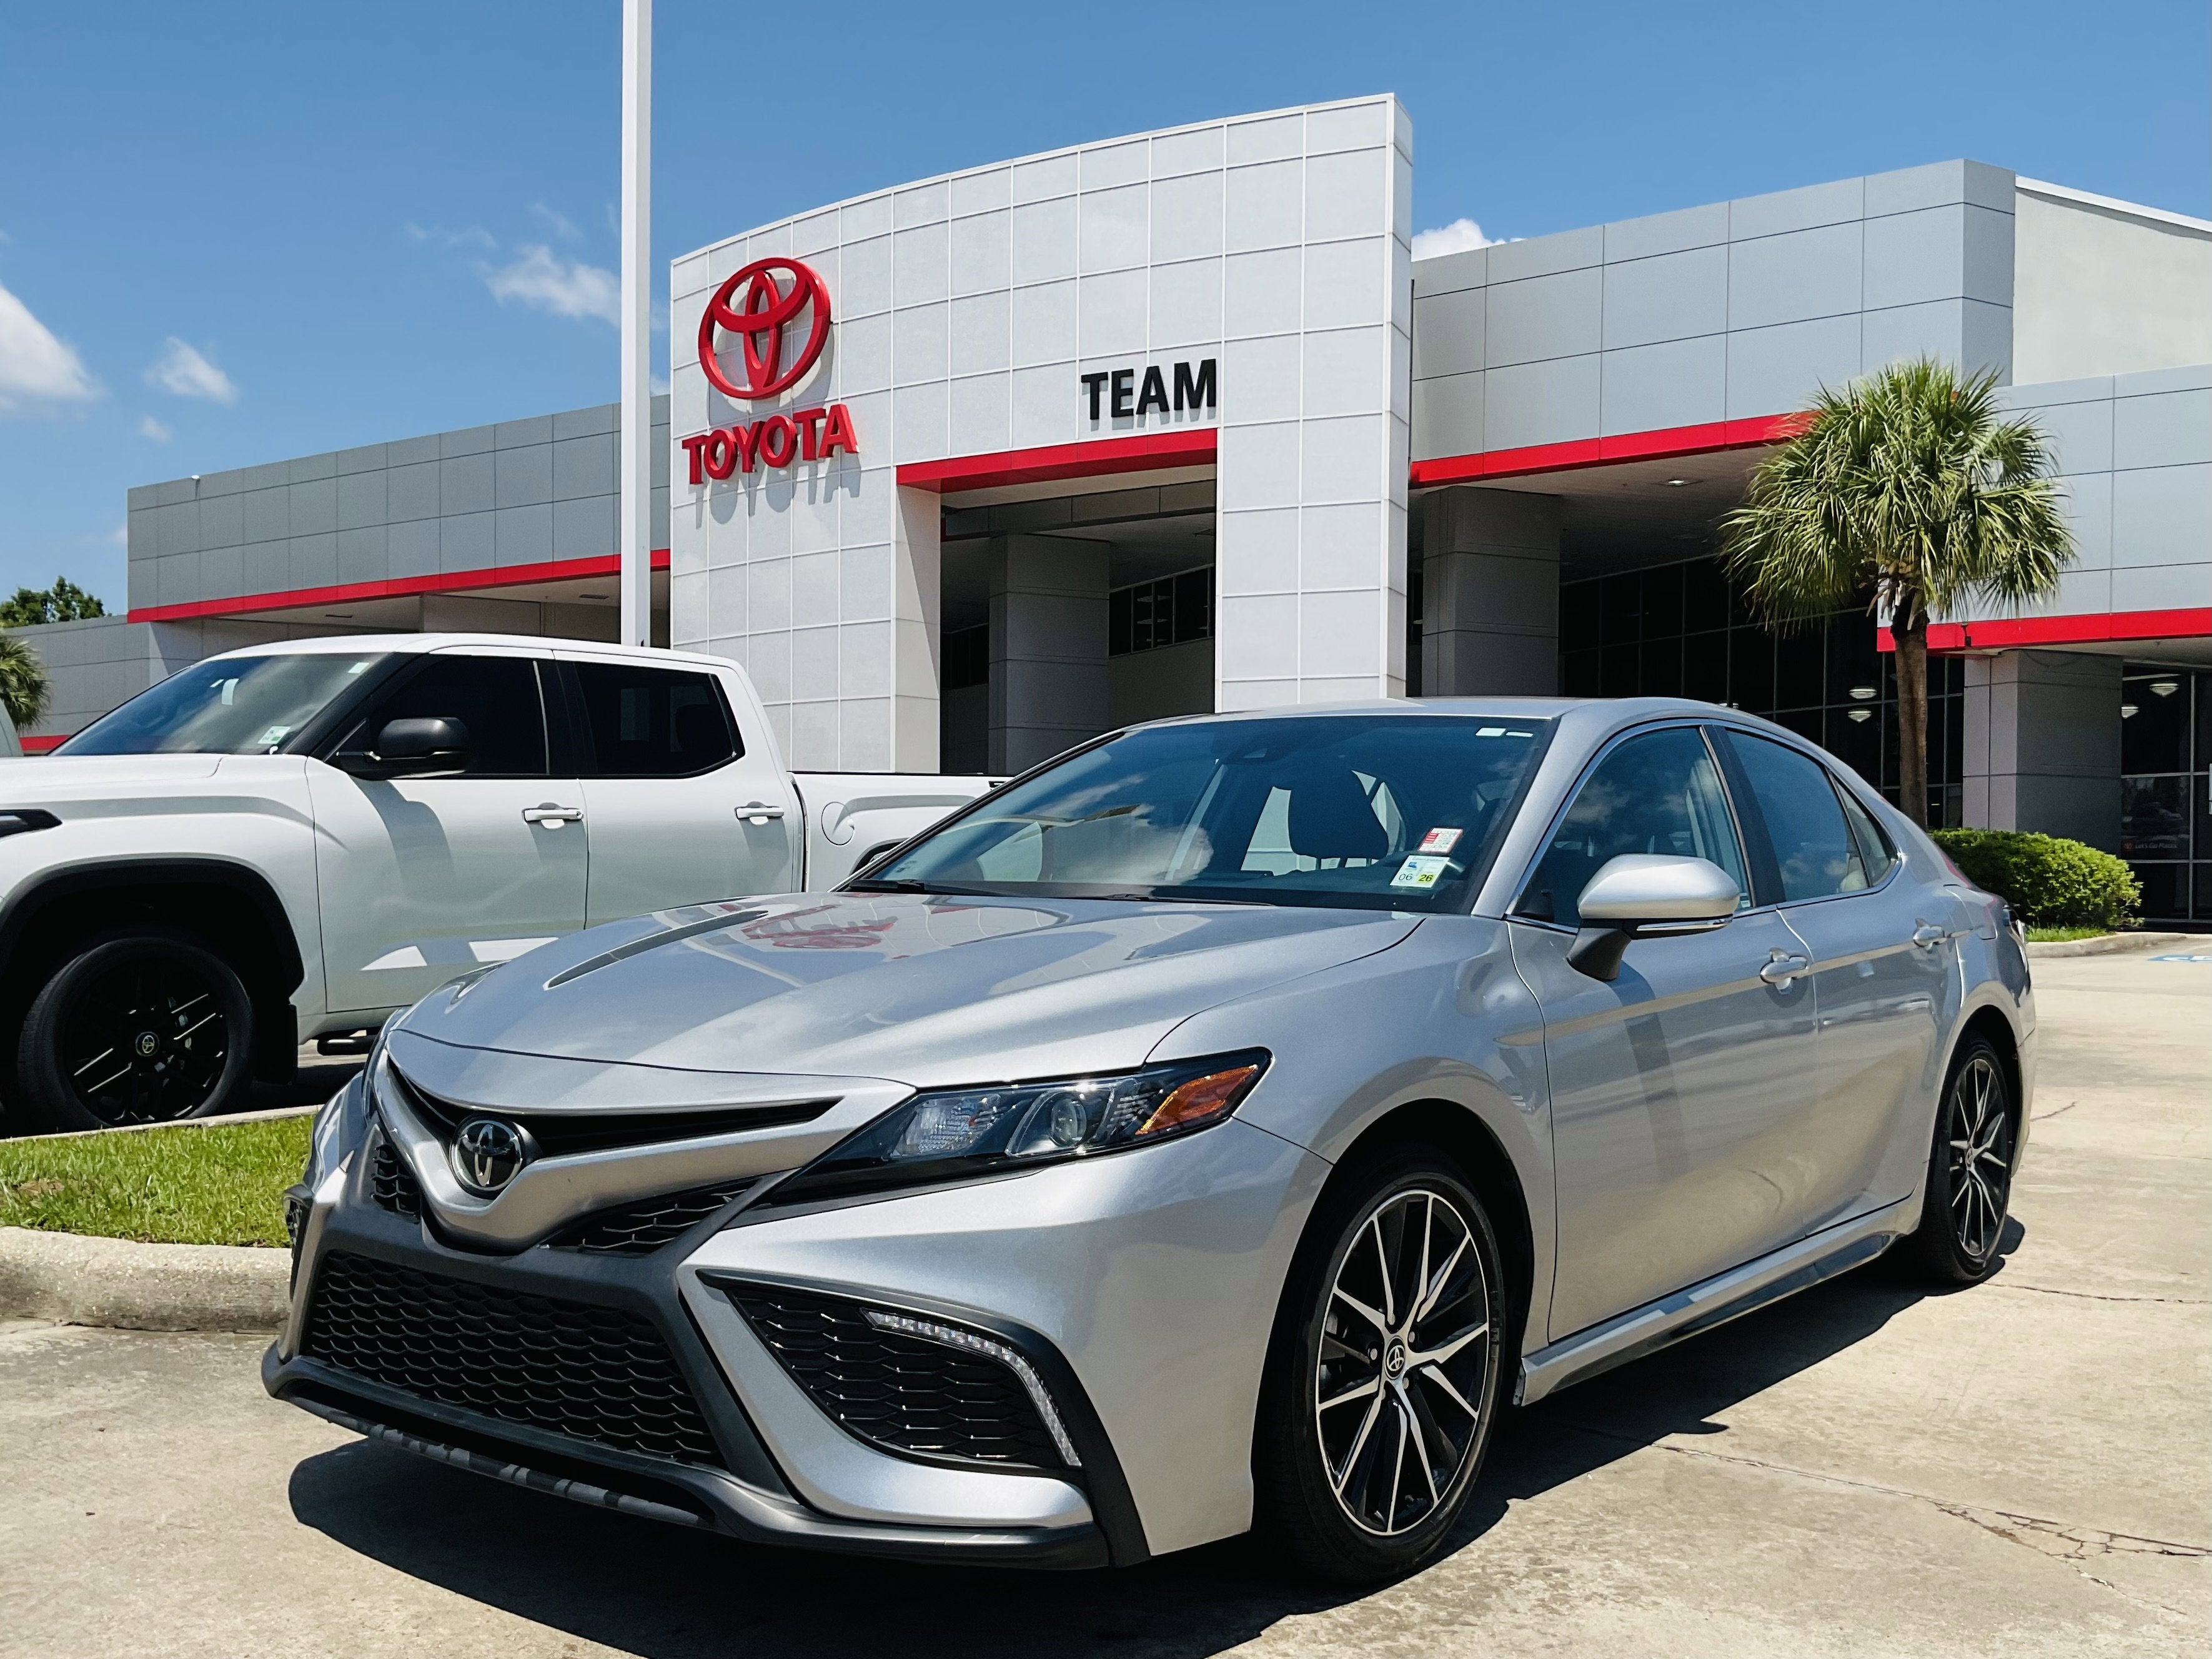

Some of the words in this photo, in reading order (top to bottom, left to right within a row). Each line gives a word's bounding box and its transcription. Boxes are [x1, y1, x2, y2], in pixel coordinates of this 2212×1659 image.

[1081, 359, 1216, 420] TEAM
[682, 404, 860, 485] TOYOTA
[1418, 874, 1433, 882] 26
